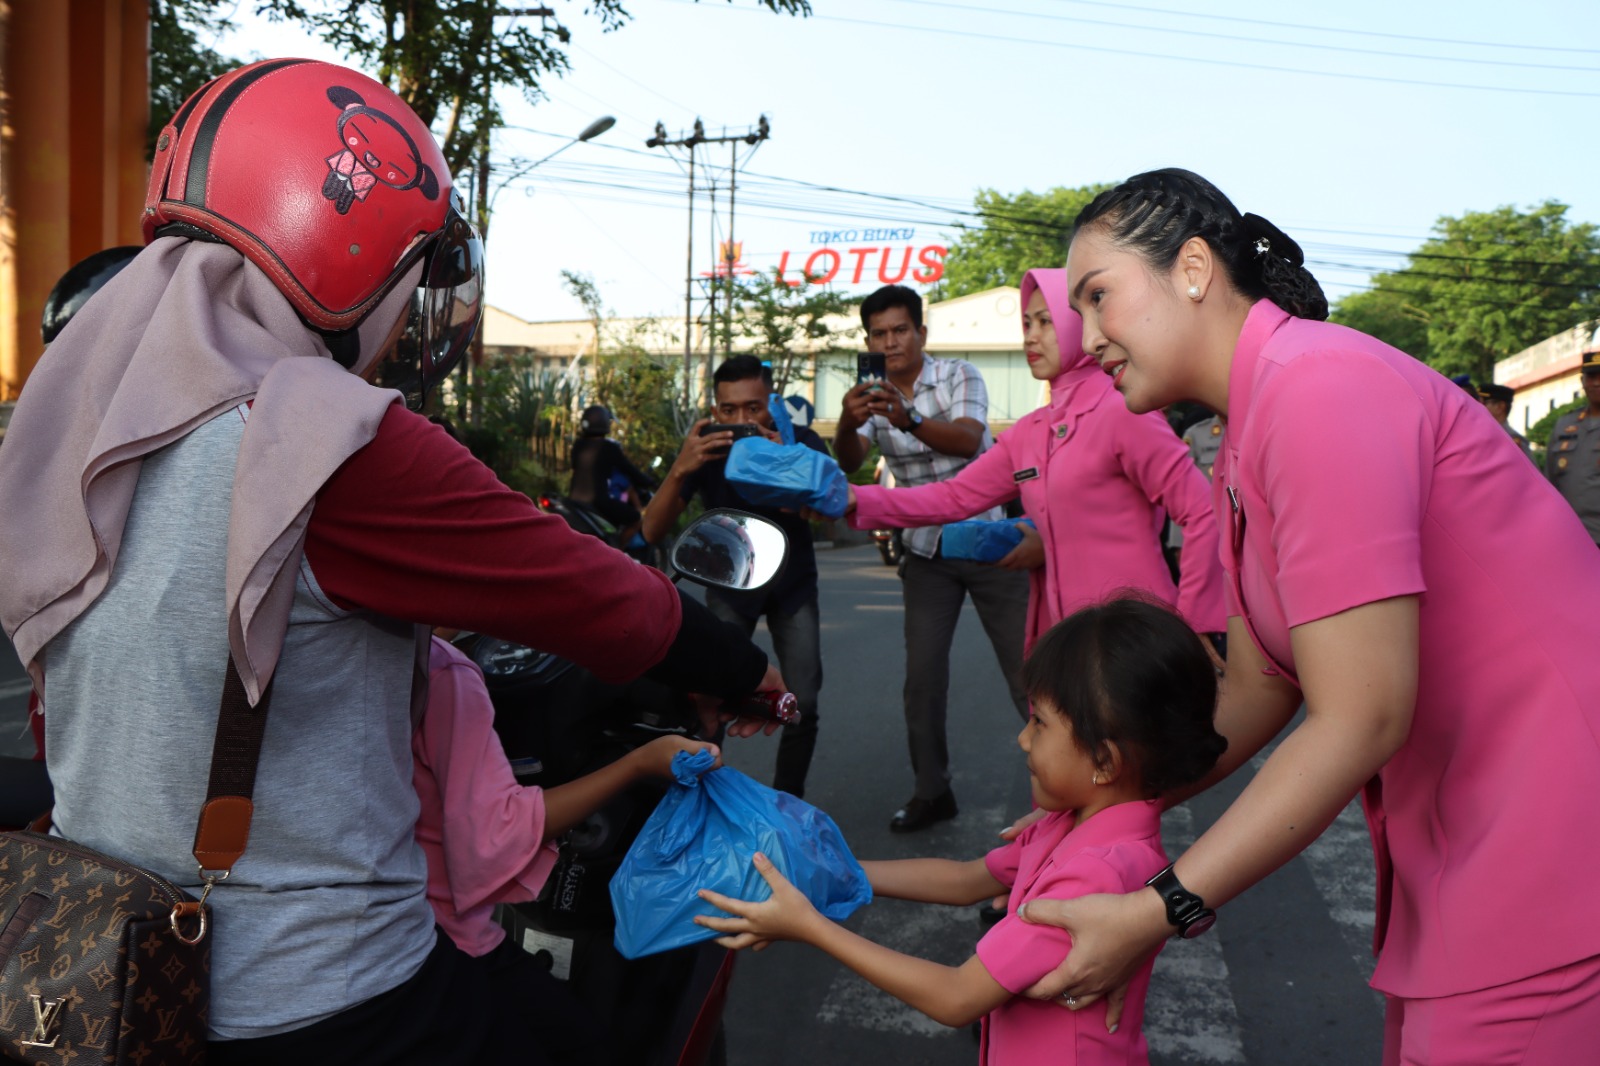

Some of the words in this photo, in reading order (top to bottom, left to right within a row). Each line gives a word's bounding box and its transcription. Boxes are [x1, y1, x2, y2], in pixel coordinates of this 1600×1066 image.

[810, 230, 858, 243] TOKO
[863, 227, 914, 240] BUKU
[776, 245, 948, 286] LOTUS
[44, 895, 81, 928] LV
[22, 994, 66, 1048] LV
[79, 1012, 112, 1049] LV
